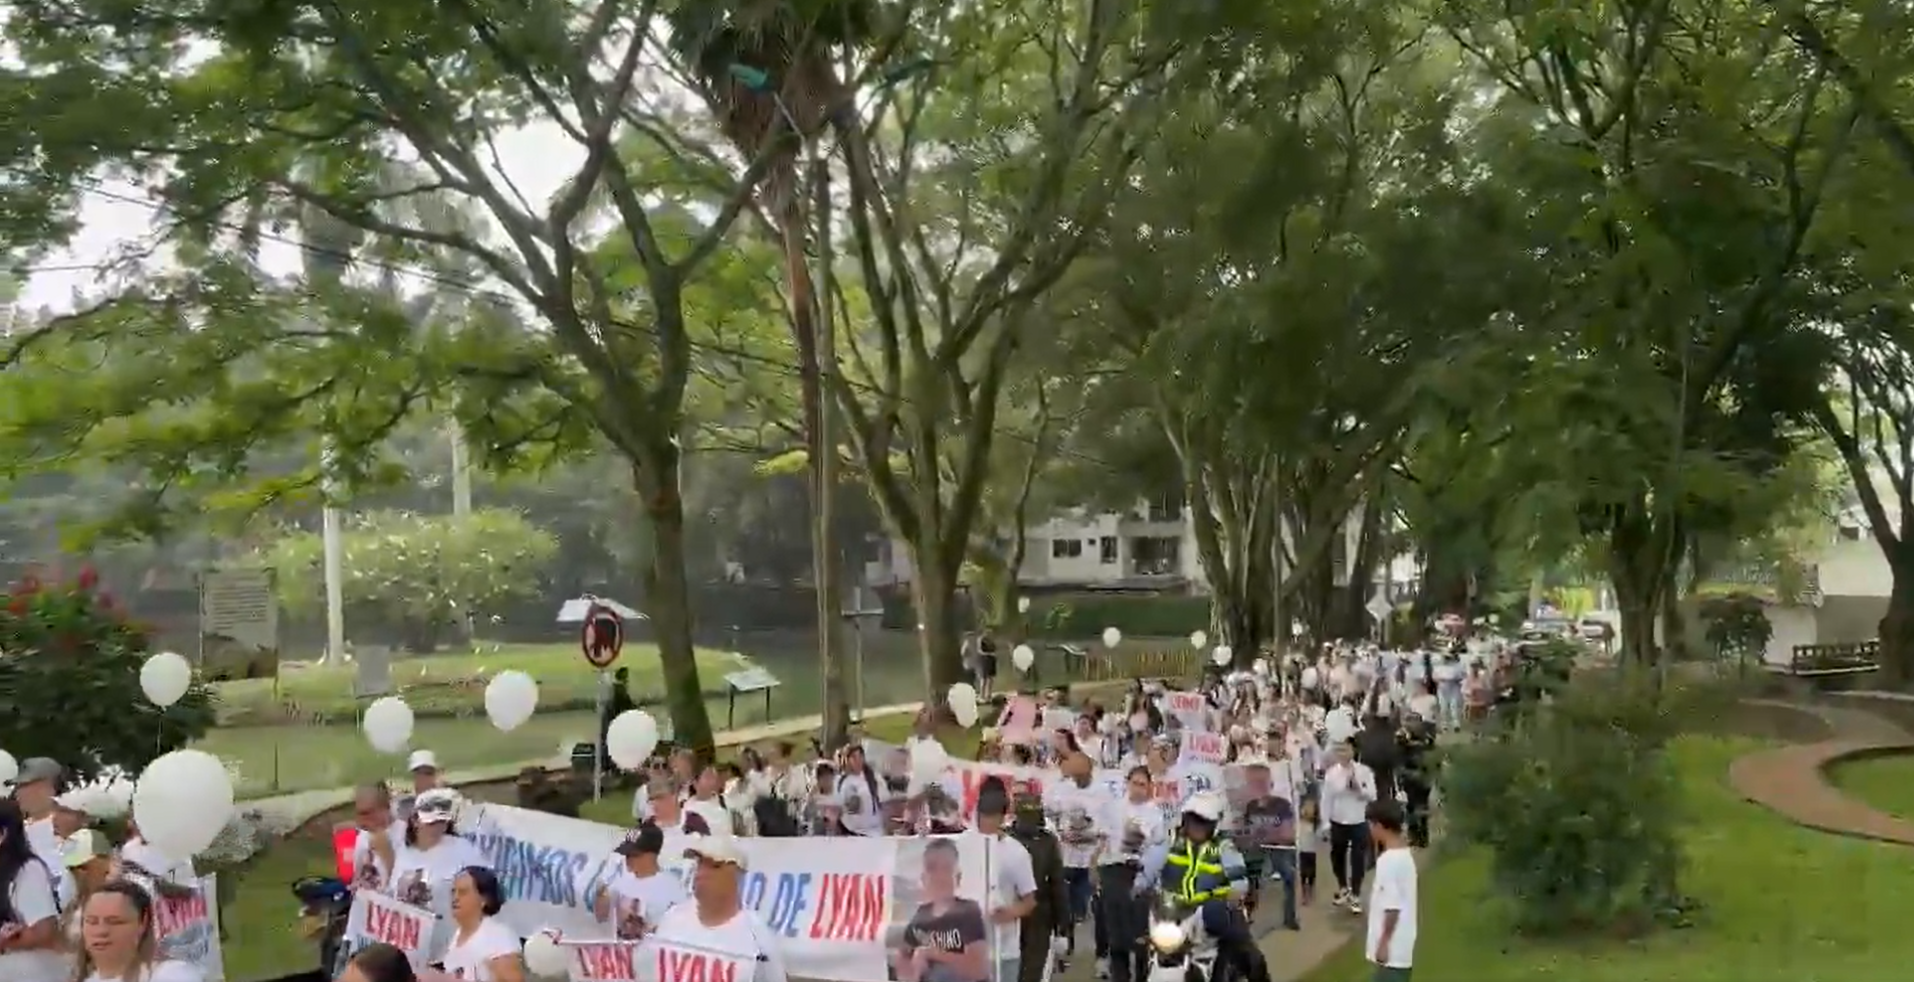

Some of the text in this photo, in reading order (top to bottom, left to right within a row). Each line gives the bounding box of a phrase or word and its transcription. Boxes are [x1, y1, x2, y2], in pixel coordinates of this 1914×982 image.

[366, 900, 421, 951] LYAN
[767, 872, 812, 938] DE
[809, 872, 885, 940] LYAN
